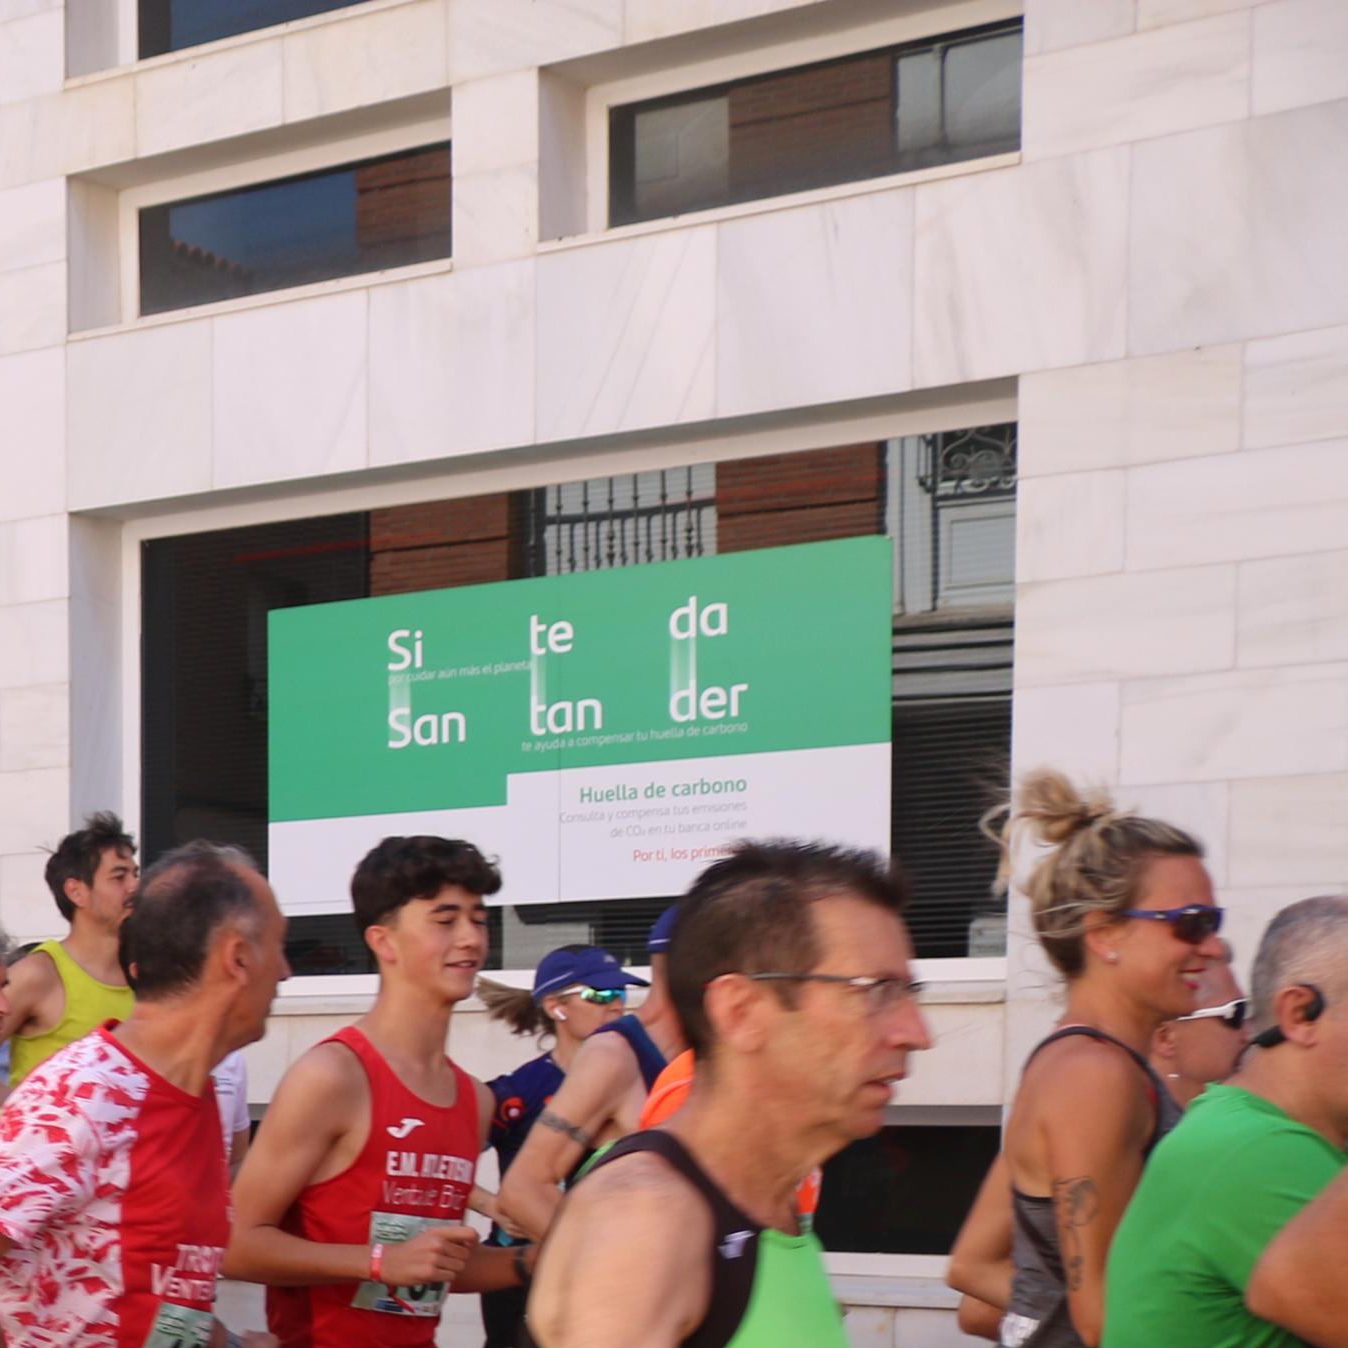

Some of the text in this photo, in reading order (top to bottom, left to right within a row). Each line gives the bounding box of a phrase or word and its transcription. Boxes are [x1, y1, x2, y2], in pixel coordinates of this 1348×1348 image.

[388, 595, 729, 671] Si te da
[482, 663, 491, 675] el
[388, 678, 748, 748] San tan der
[521, 721, 748, 753] te ayuda a compensar tu huella de carbono
[579, 777, 747, 804] Huella de carbono
[559, 801, 747, 824] Consulta y compensa tus emisiones
[610, 826, 624, 838] de
[647, 825, 663, 835] en
[664, 823, 677, 834] tu
[678, 820, 711, 834] banca
[712, 818, 747, 832] online
[633, 849, 653, 862] Por
[670, 847, 688, 859] los
[690, 845, 736, 861] prime
